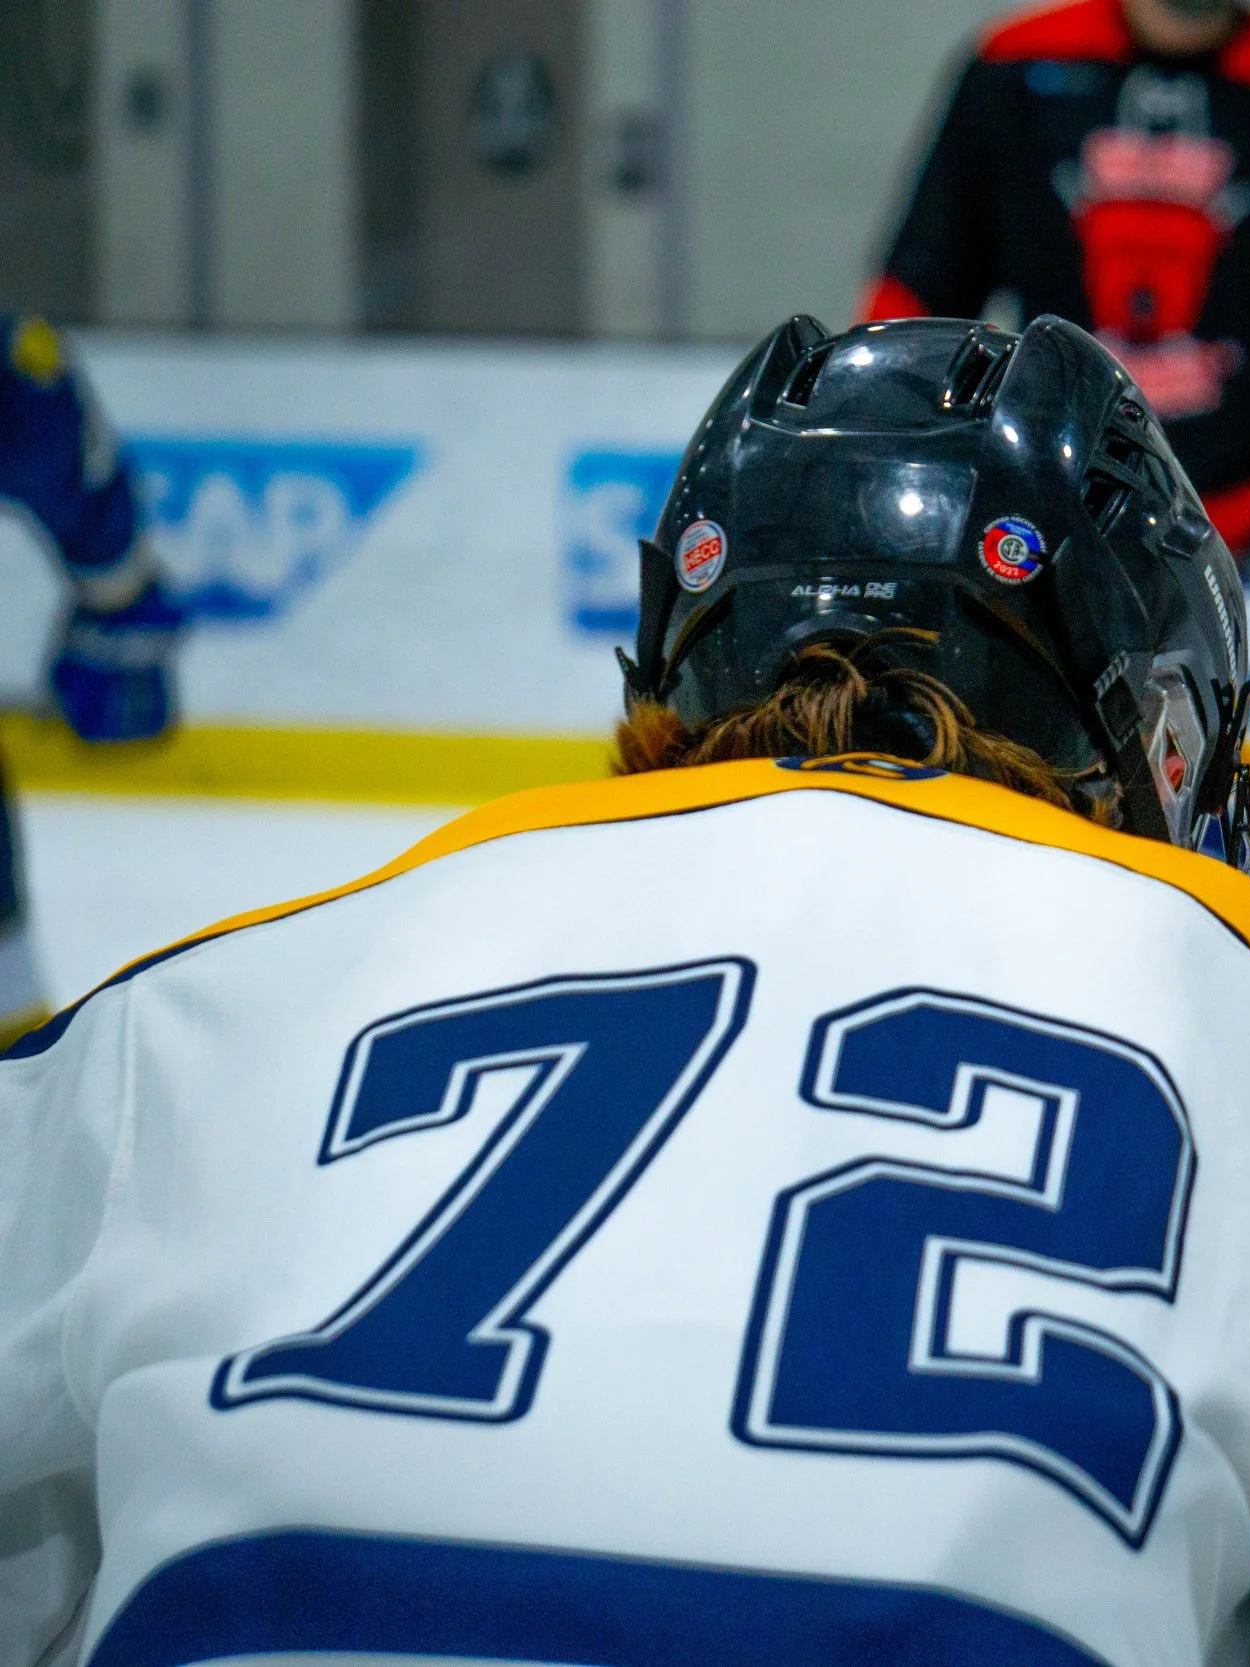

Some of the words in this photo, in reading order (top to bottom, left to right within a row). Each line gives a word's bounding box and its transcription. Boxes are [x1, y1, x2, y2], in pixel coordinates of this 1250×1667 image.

[993, 560, 1019, 577] 2022
[790, 584, 861, 598] ALPHA
[865, 582, 897, 591] ONE
[863, 591, 896, 600] PRO
[208, 956, 1197, 1553] 72
